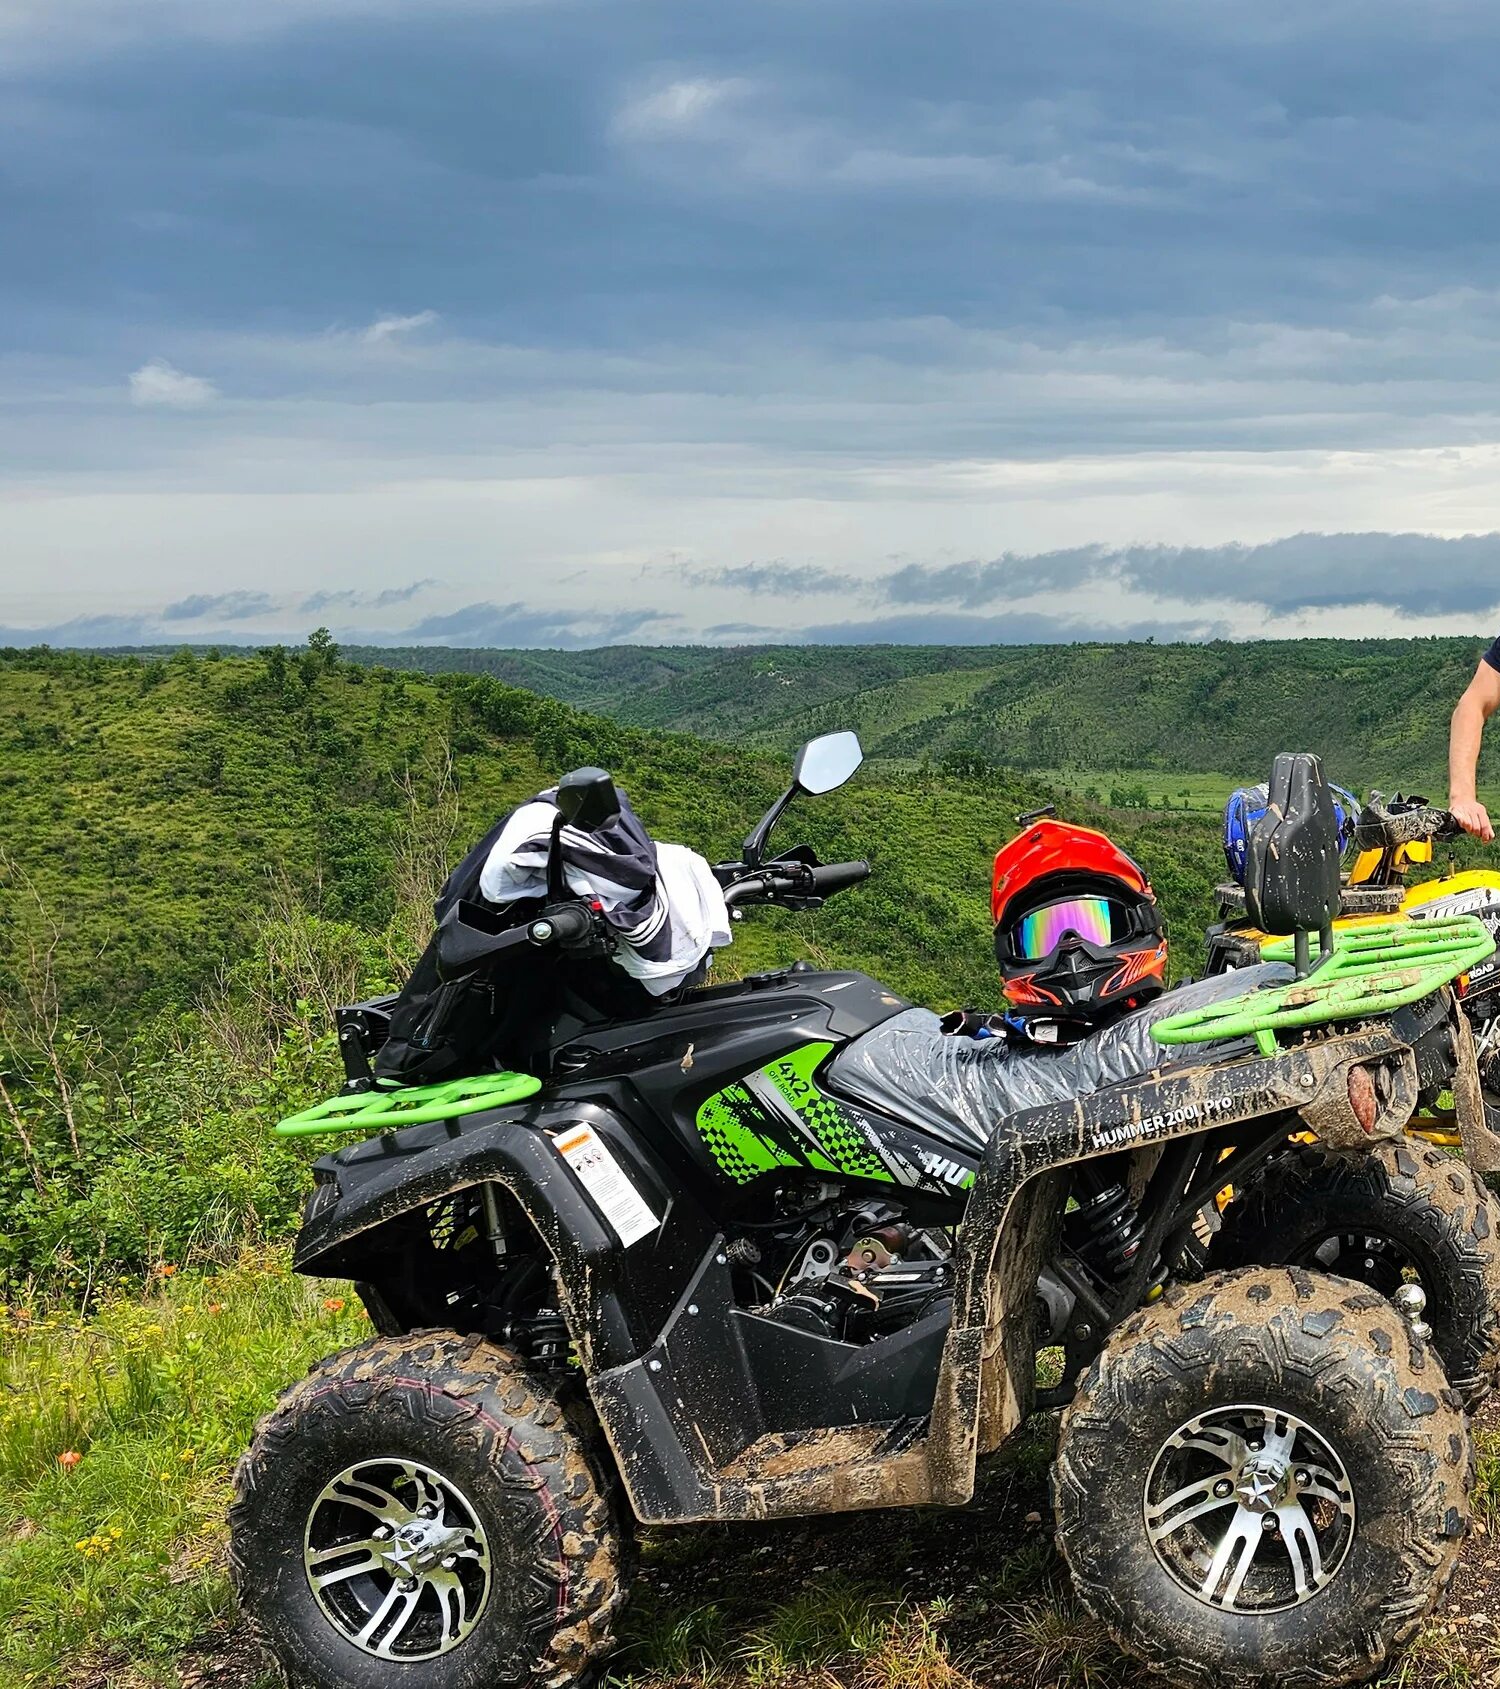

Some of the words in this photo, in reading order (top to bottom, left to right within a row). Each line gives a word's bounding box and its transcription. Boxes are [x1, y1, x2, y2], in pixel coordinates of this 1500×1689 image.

[769, 1070, 781, 1083] OFF
[779, 1083, 795, 1102] ROAD
[778, 1062, 810, 1098] 4X2
[1092, 1115, 1165, 1149] HUMMER
[1204, 1096, 1232, 1115] Pro
